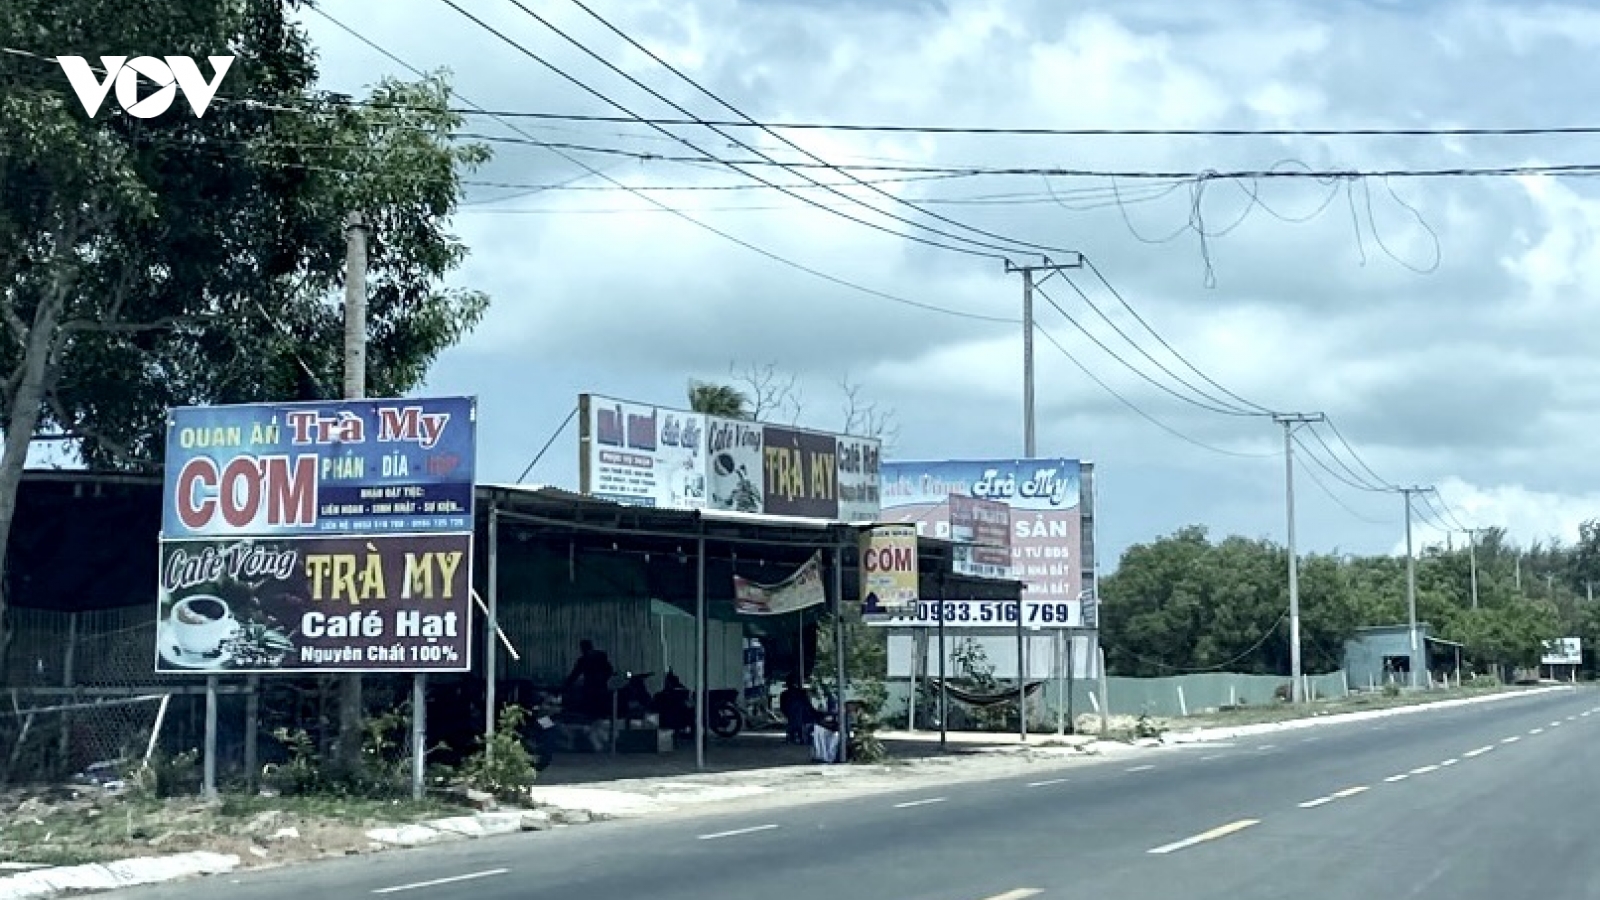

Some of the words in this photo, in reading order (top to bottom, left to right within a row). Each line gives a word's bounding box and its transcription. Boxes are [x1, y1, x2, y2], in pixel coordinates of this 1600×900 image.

[286, 410, 365, 445] Trà
[377, 407, 450, 448] My
[765, 437, 804, 503] TRÀ
[811, 450, 835, 500] MY
[1019, 468, 1069, 506] My
[176, 453, 318, 530] CƠM
[1016, 514, 1067, 538] SẢN
[305, 542, 386, 605] TRÀ
[401, 553, 463, 599] MY
[864, 544, 913, 573] CƠM
[302, 610, 384, 637] Café
[397, 610, 457, 642] Hạt
[301, 645, 362, 664] Nguyên
[367, 642, 405, 662] Chất
[410, 646, 458, 662] 100%
